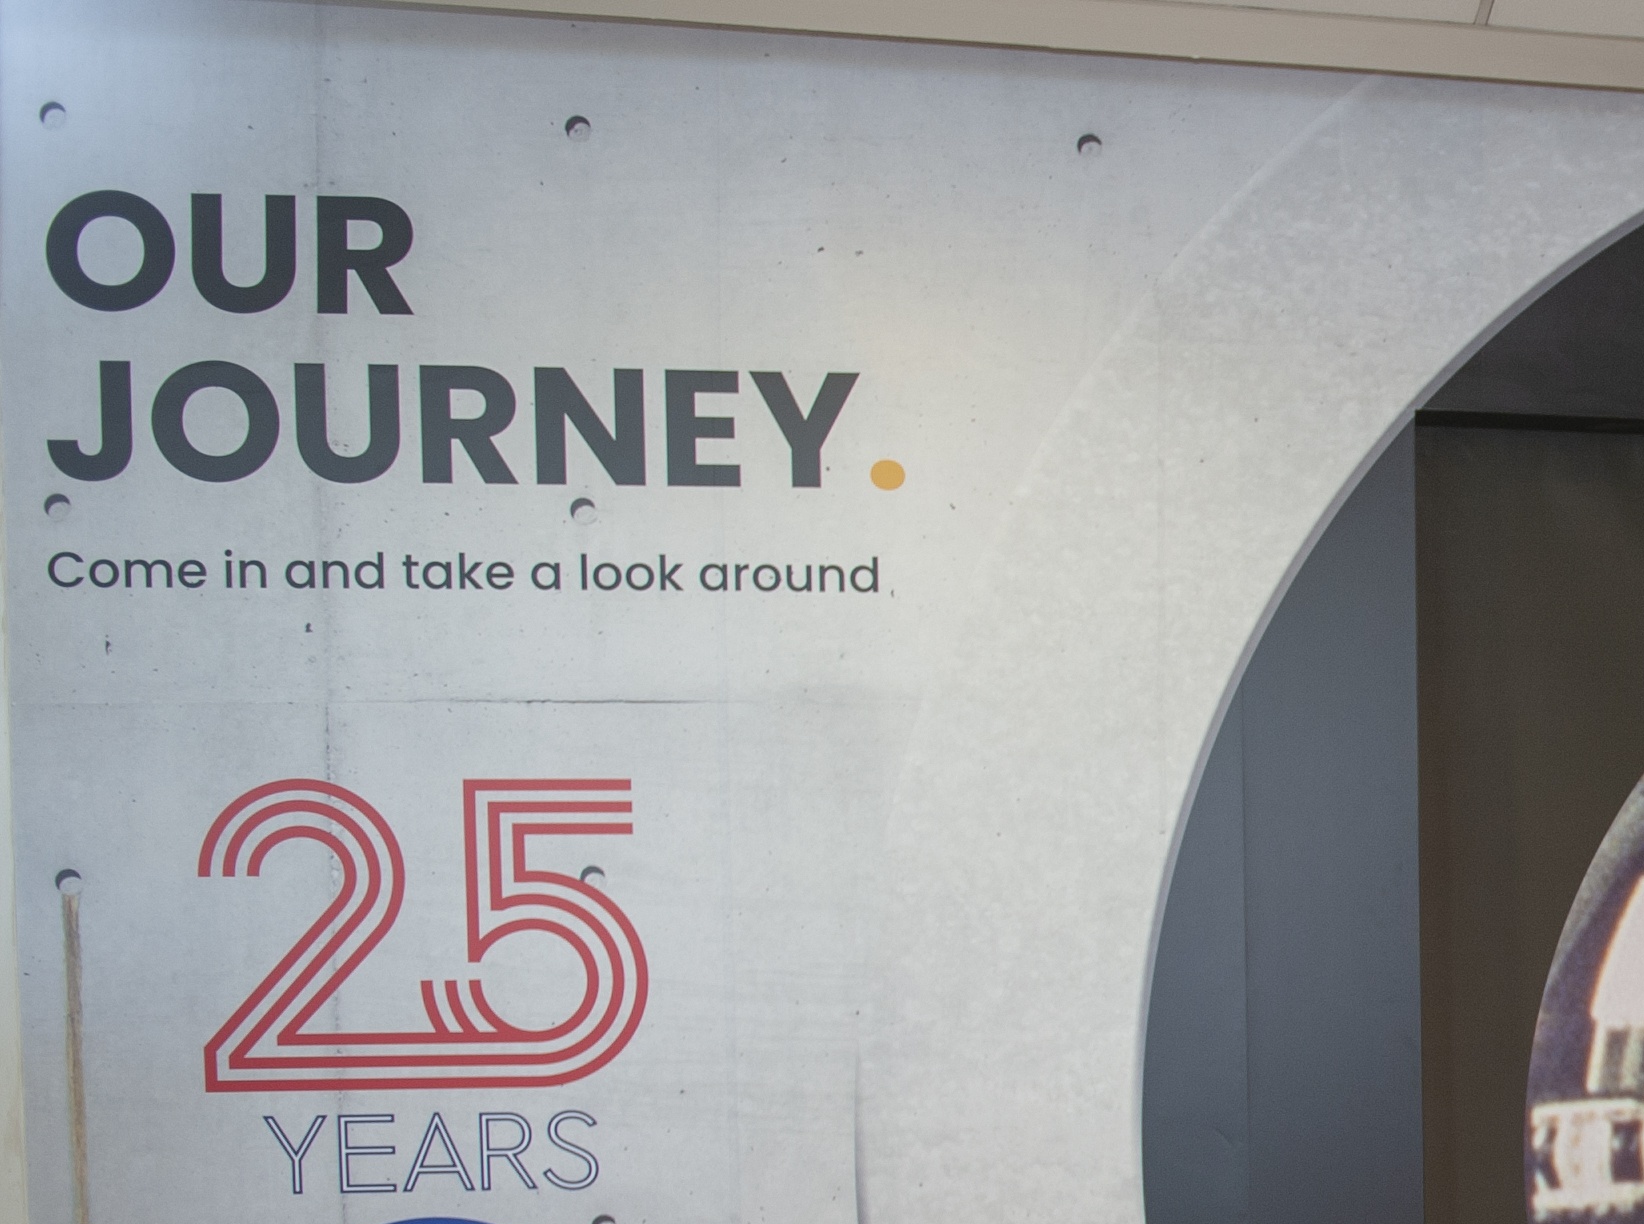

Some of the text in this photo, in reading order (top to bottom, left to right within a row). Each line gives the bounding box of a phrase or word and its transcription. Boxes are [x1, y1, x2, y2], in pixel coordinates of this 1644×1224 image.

[46, 190, 414, 316] OUR
[47, 360, 906, 491] JOURNEY.
[47, 550, 879, 593] Come in and take a look around
[198, 779, 649, 1093] 25
[263, 1110, 600, 1195] YEARS
